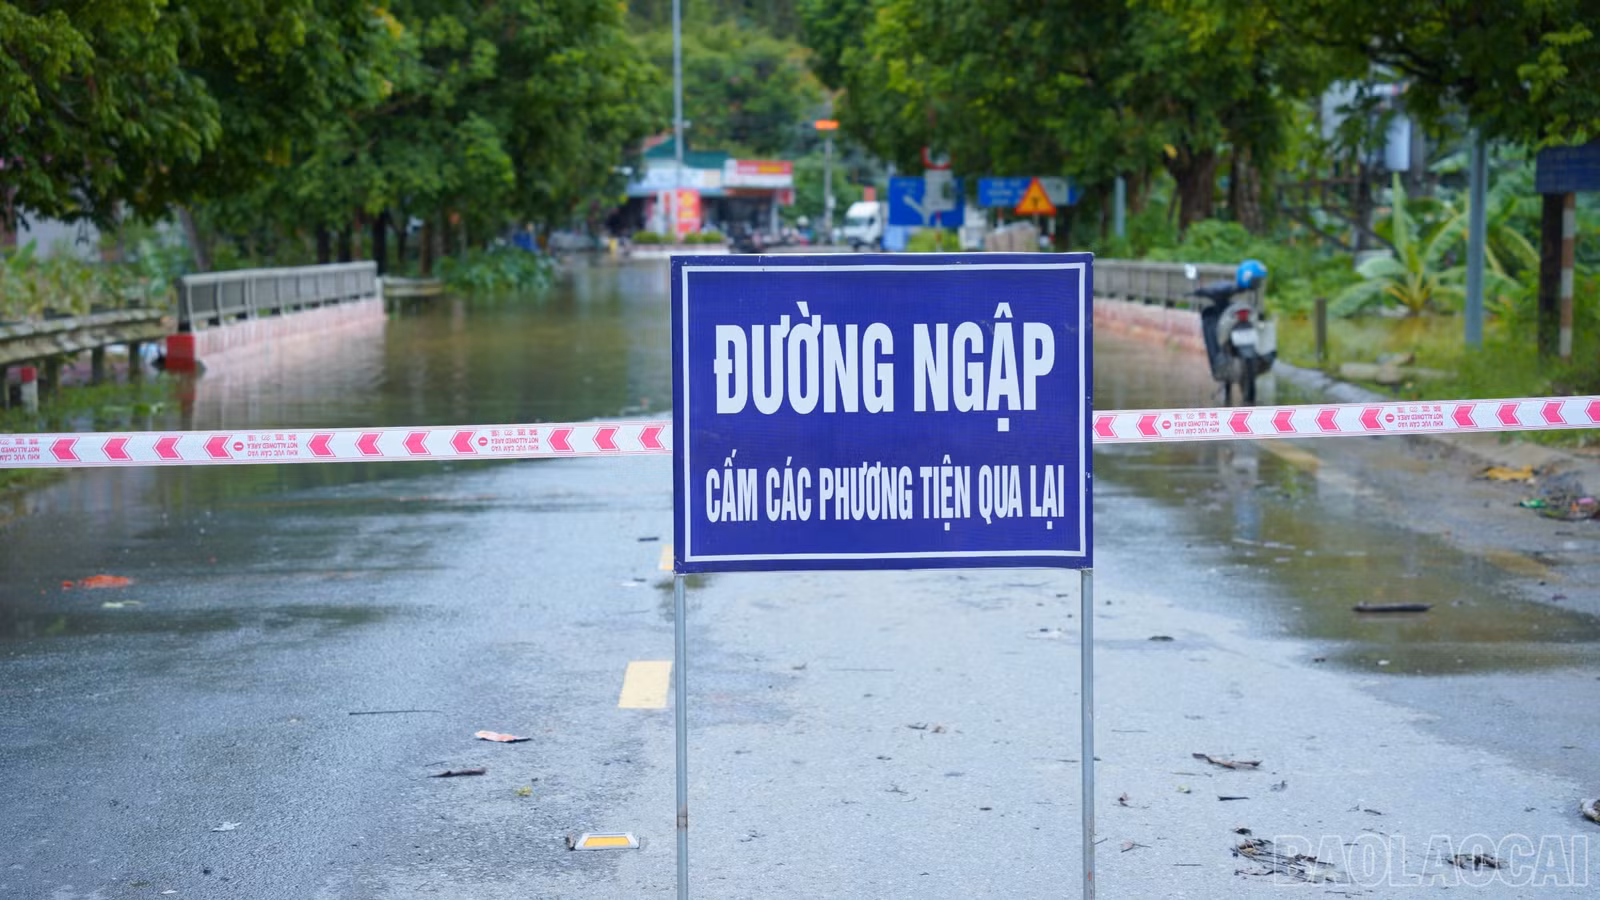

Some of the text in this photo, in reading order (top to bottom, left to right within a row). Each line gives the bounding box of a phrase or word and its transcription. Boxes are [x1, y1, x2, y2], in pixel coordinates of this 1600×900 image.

[713, 301, 1056, 432] ĐƯỜNG NGẬP
[705, 449, 1065, 531] CẤM CÁC PHƯƠNG TIỆN QUA LẠI
